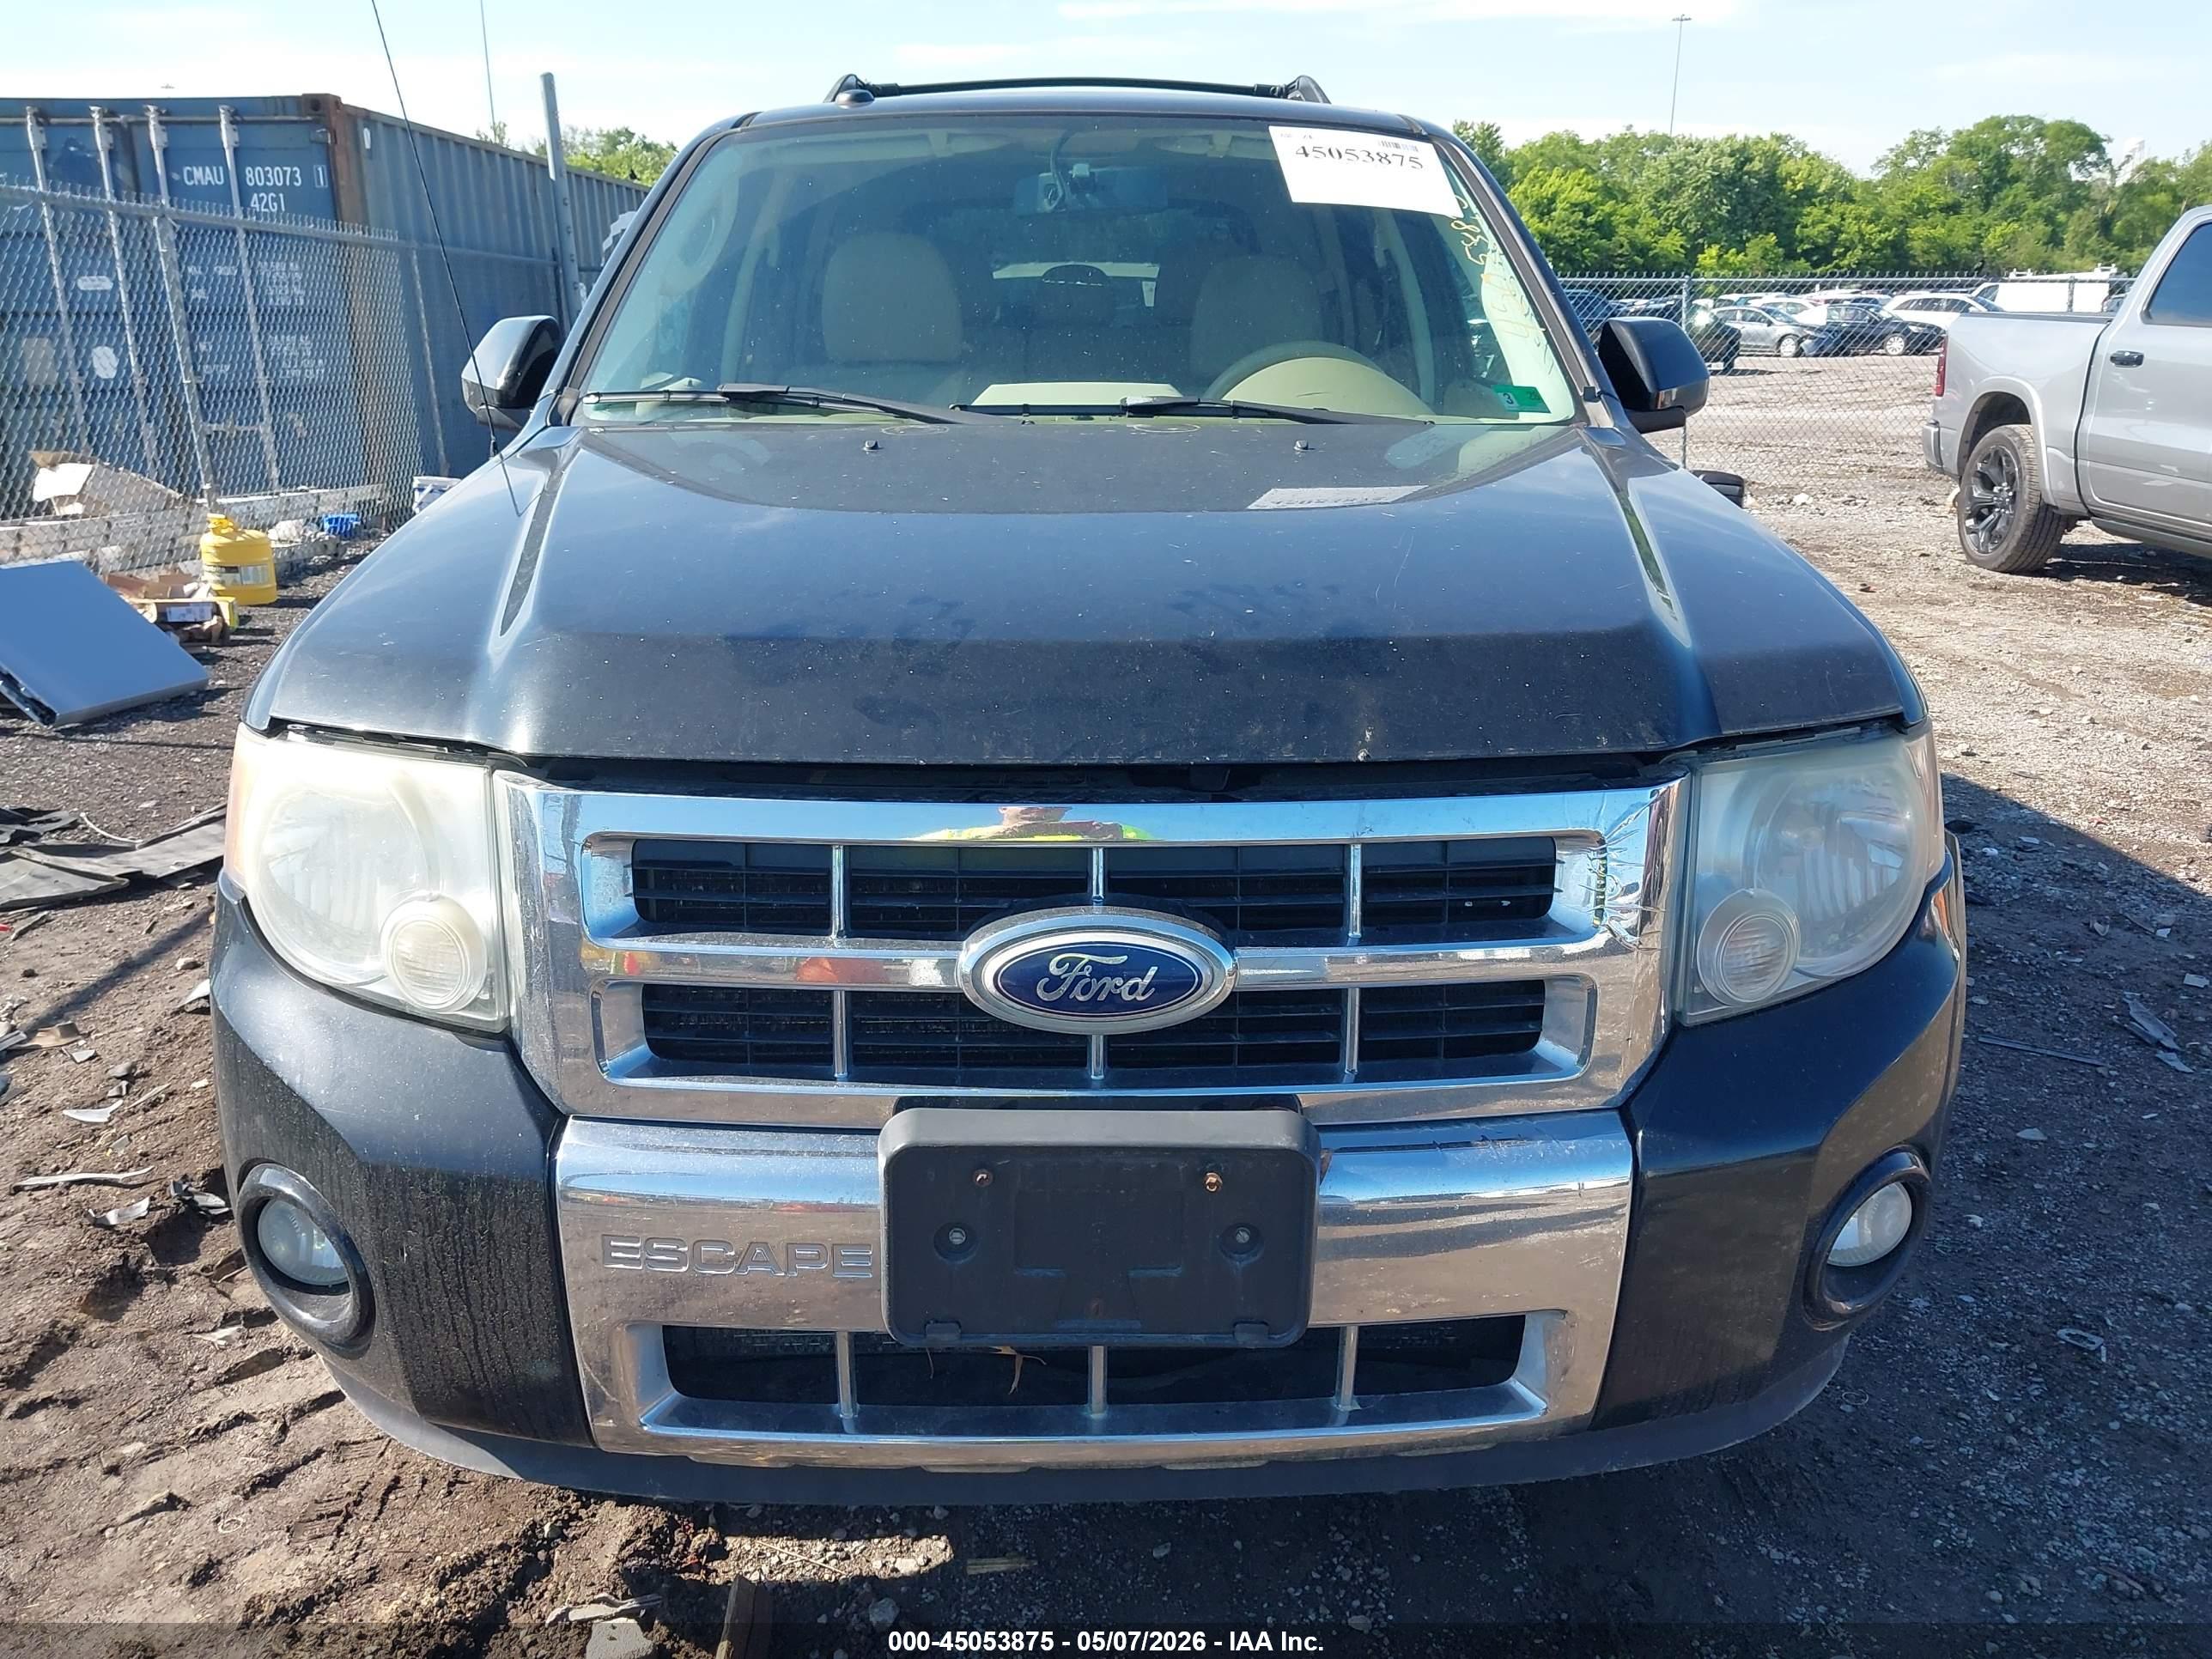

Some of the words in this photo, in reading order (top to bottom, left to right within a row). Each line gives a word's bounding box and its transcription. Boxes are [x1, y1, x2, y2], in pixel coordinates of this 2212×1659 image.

[1295, 144, 1424, 170] 45053875
[182, 166, 224, 186] CMAU
[245, 166, 302, 187] 803073
[1503, 392, 1514, 404] 3
[1036, 952, 1158, 1002] Ford
[601, 1234, 873, 1278] ESCAPE
